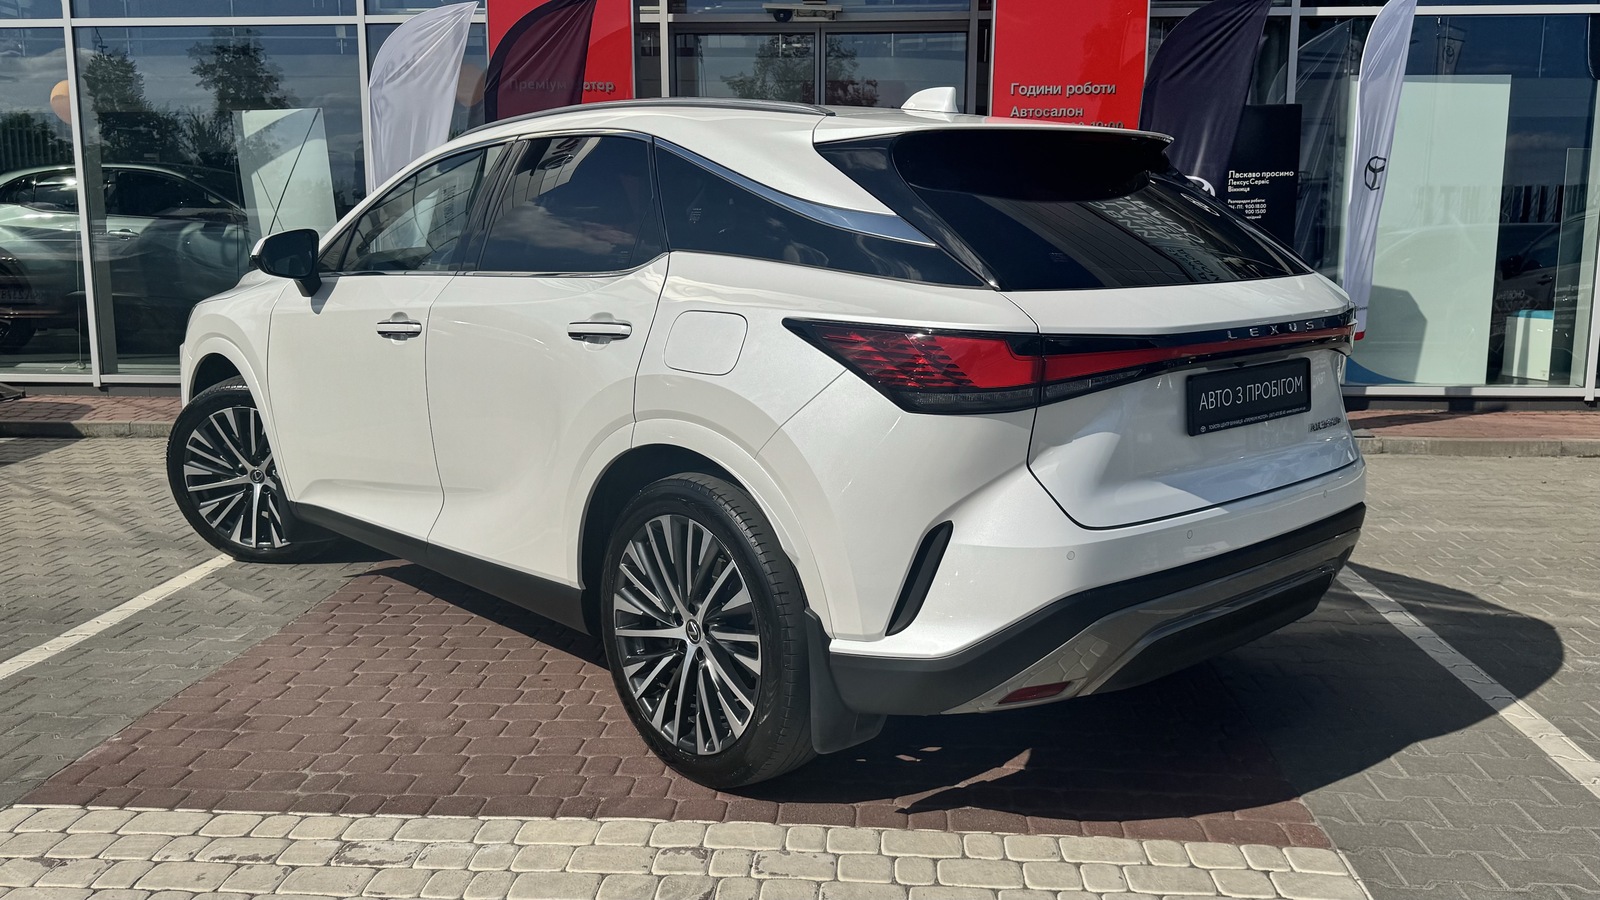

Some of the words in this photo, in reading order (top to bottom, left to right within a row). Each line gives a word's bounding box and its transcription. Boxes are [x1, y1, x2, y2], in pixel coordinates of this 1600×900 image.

[583, 81, 615, 95] отор
[1010, 83, 1062, 96] Години
[1066, 82, 1116, 97] роботи
[1010, 106, 1084, 117] Автосалон
[1228, 170, 1260, 178] Ласкаво
[1227, 320, 1315, 340] LEXUS
[1199, 388, 1233, 411] АВТО
[1246, 375, 1303, 402] ПРОБІГОМ
